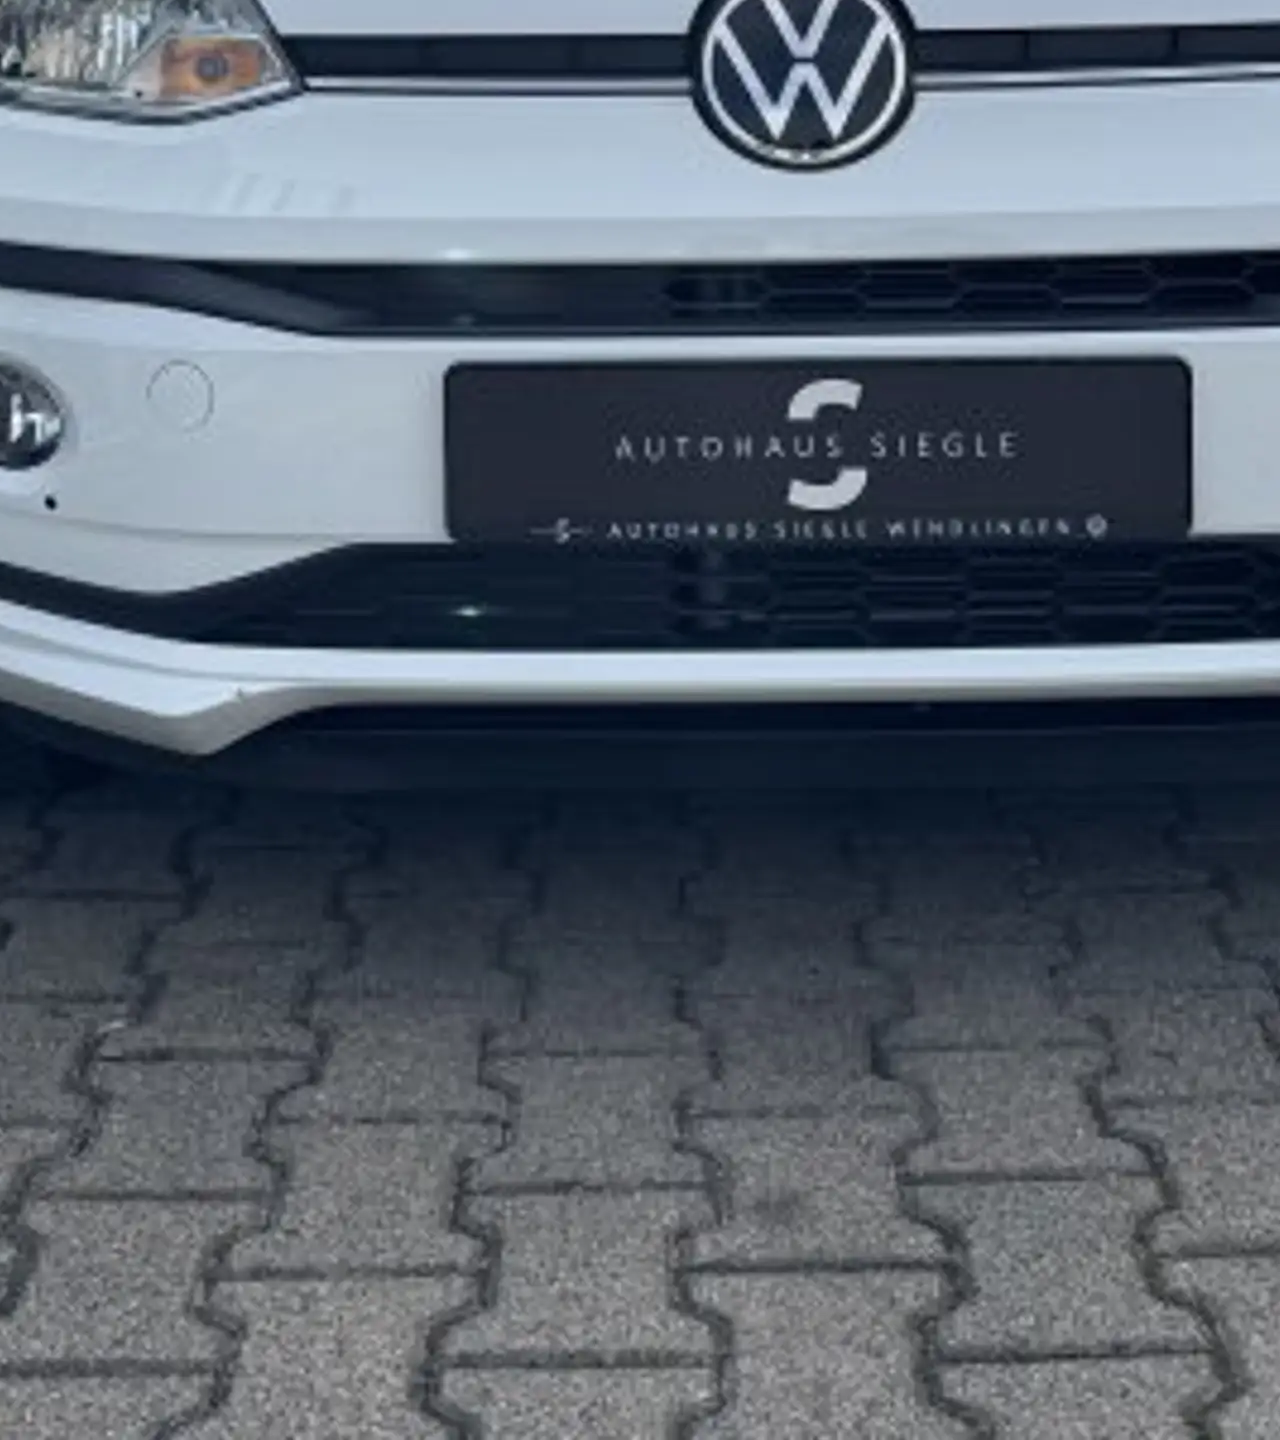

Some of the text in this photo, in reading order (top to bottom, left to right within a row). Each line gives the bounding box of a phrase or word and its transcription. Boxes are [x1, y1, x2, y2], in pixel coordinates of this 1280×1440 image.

[615, 430, 1018, 462] AUTOHAUS SIEGLE
[607, 519, 758, 541] AUTOHAUS
[773, 519, 868, 540] SIEGLE
